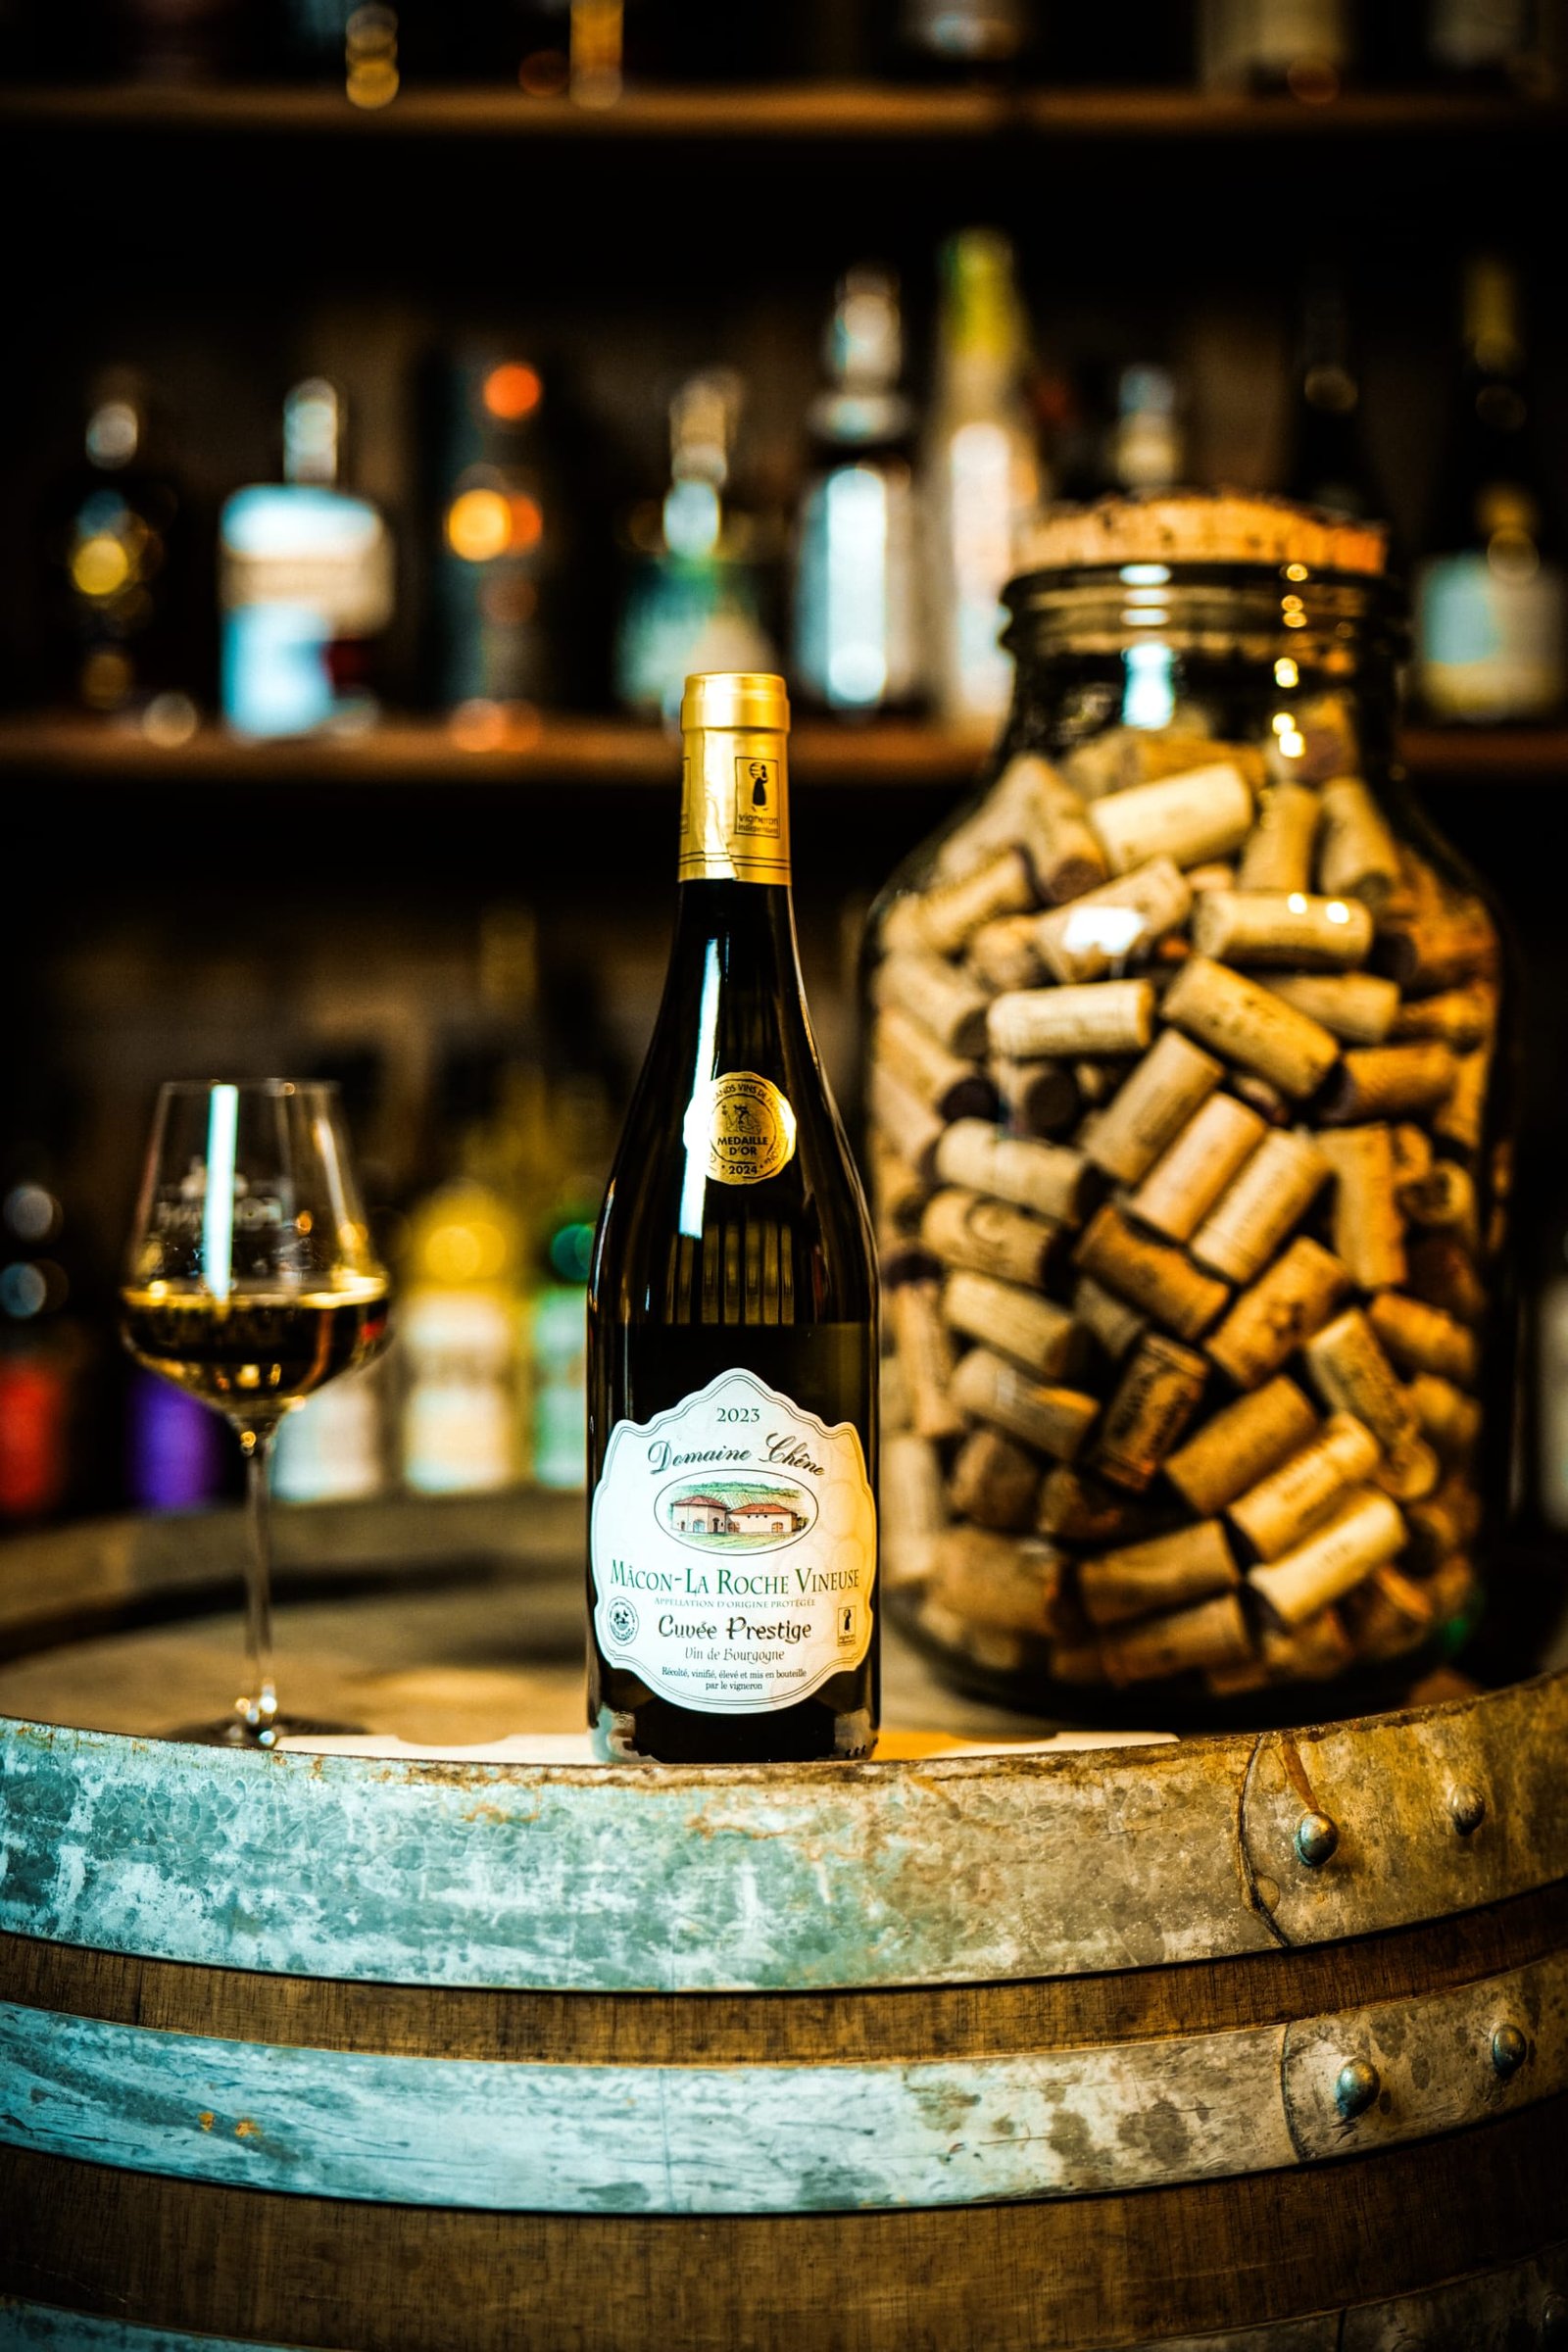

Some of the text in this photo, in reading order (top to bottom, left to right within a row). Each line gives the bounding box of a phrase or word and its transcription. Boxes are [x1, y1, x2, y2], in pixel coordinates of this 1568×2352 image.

[738, 1083, 757, 1095] VINS
[717, 1136, 769, 1146] MEDAILLE
[729, 1166, 758, 1175] 2024
[716, 1408, 760, 1423] 2023
[648, 1433, 825, 1477] Domaine Chêne
[654, 1597, 816, 1609] APPELLATION D'ORIGINE PROTÉGÉE
[659, 1614, 717, 1640] Cuvée
[725, 1617, 812, 1644] Prestige
[684, 1646, 785, 1665] Vin de Bourgogne
[662, 1666, 690, 1678] Récolté,
[691, 1669, 717, 1680] vinifié,
[718, 1669, 739, 1679] élevé
[740, 1670, 748, 1679] et
[749, 1670, 764, 1679] mis
[776, 1668, 807, 1678] bouteille
[705, 1681, 762, 1691] par le vigneron
